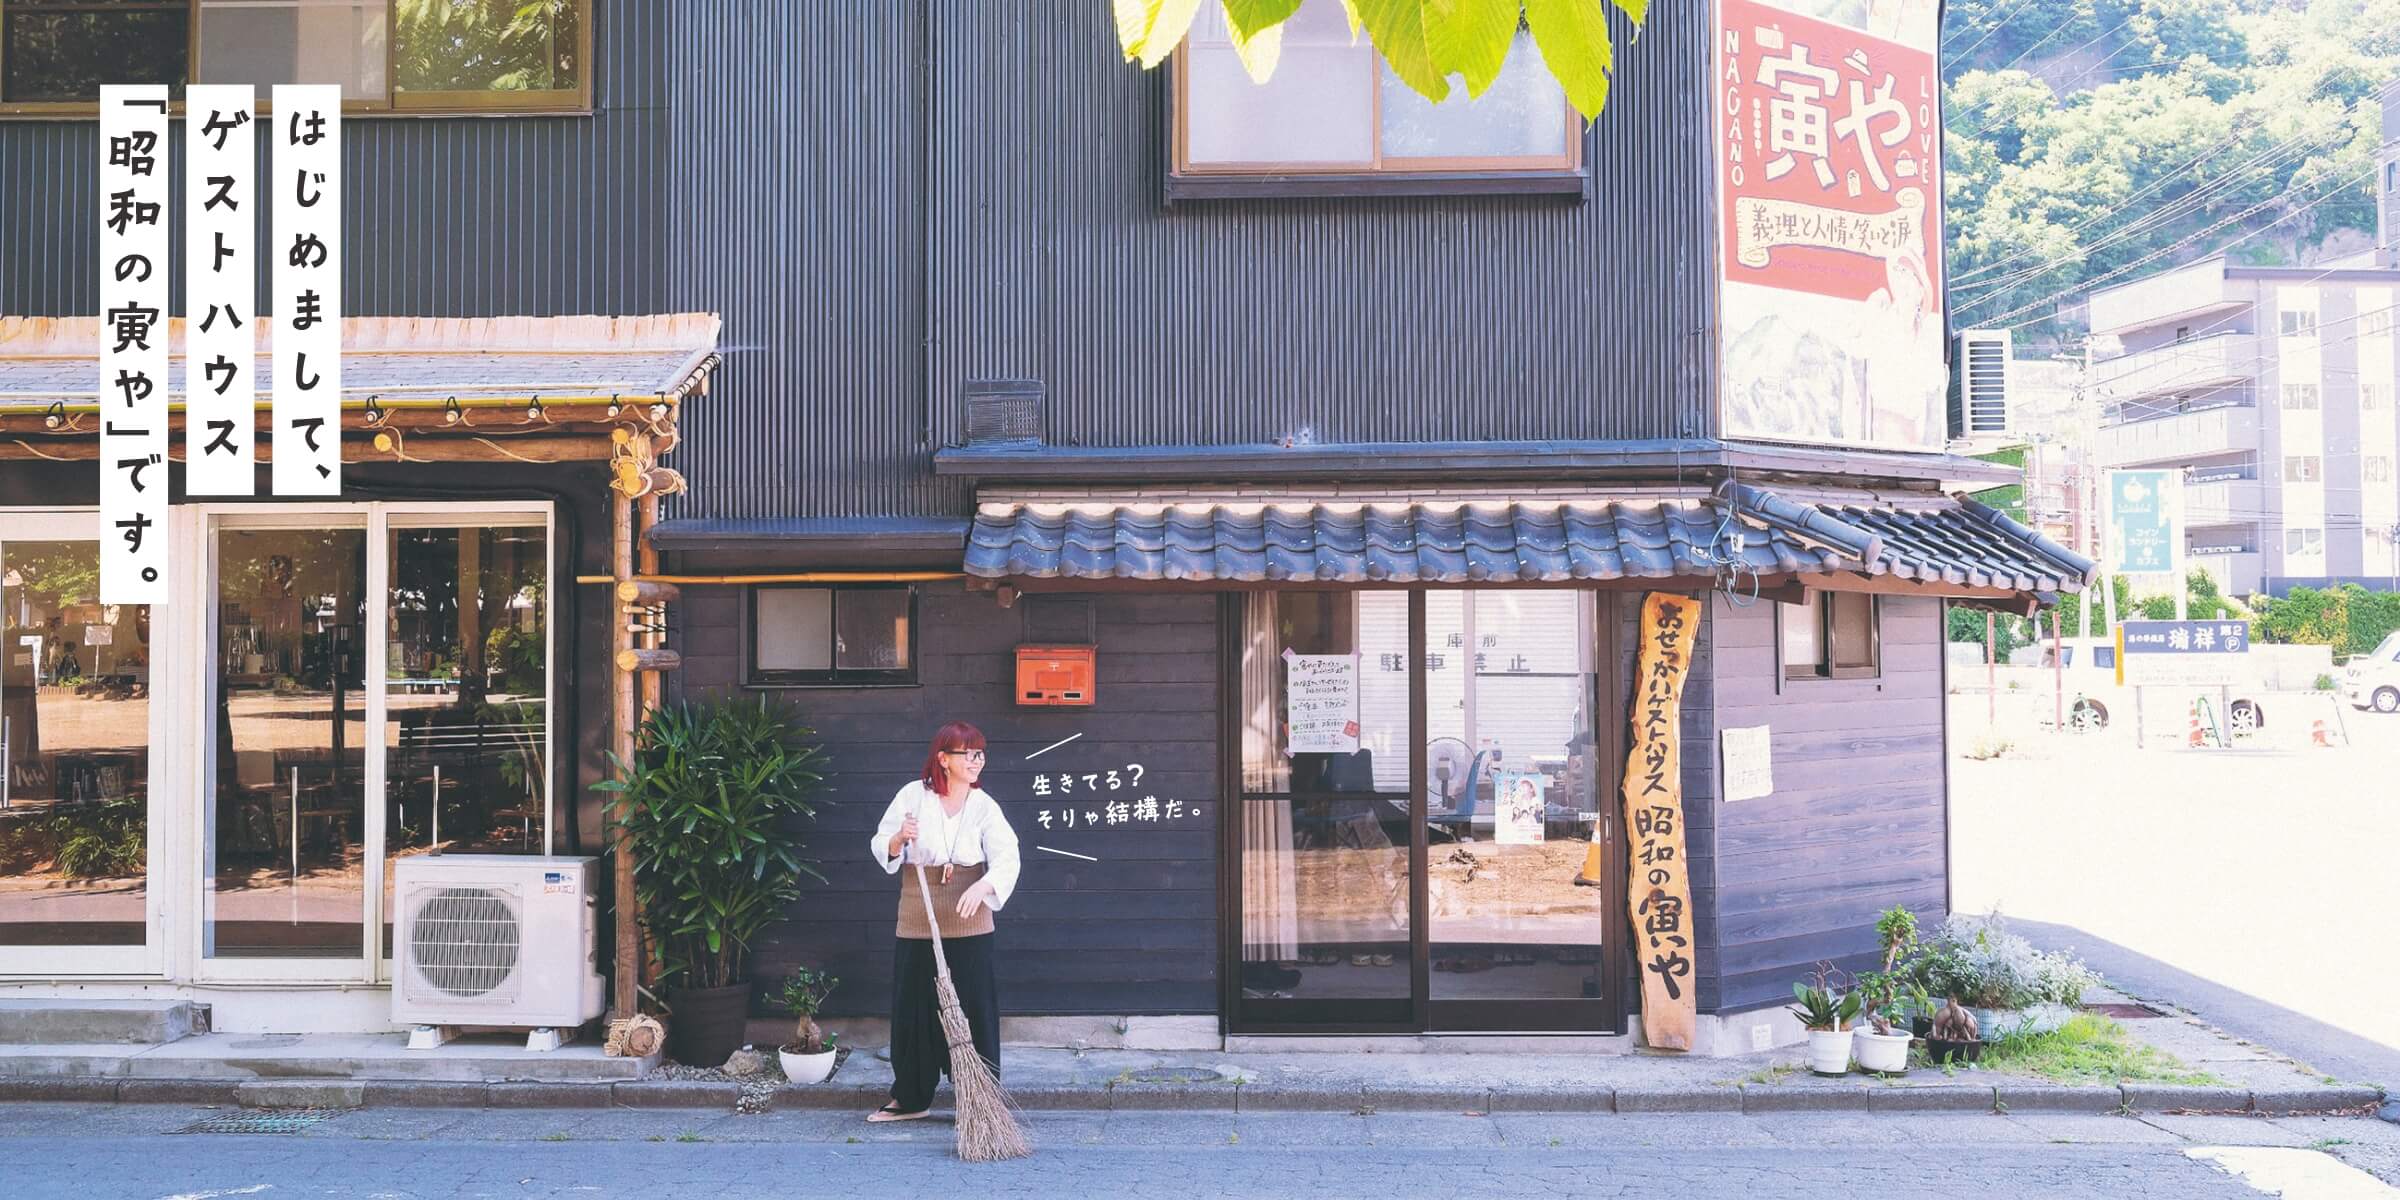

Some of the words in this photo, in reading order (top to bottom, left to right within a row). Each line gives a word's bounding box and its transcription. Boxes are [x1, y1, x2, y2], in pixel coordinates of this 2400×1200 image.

[1726, 30, 1744, 187] NAGANO
[1755, 42, 1912, 192] 寅や
[1919, 75, 1932, 184] LOVE
[1635, 805, 1690, 1000] 昭和の寅や
